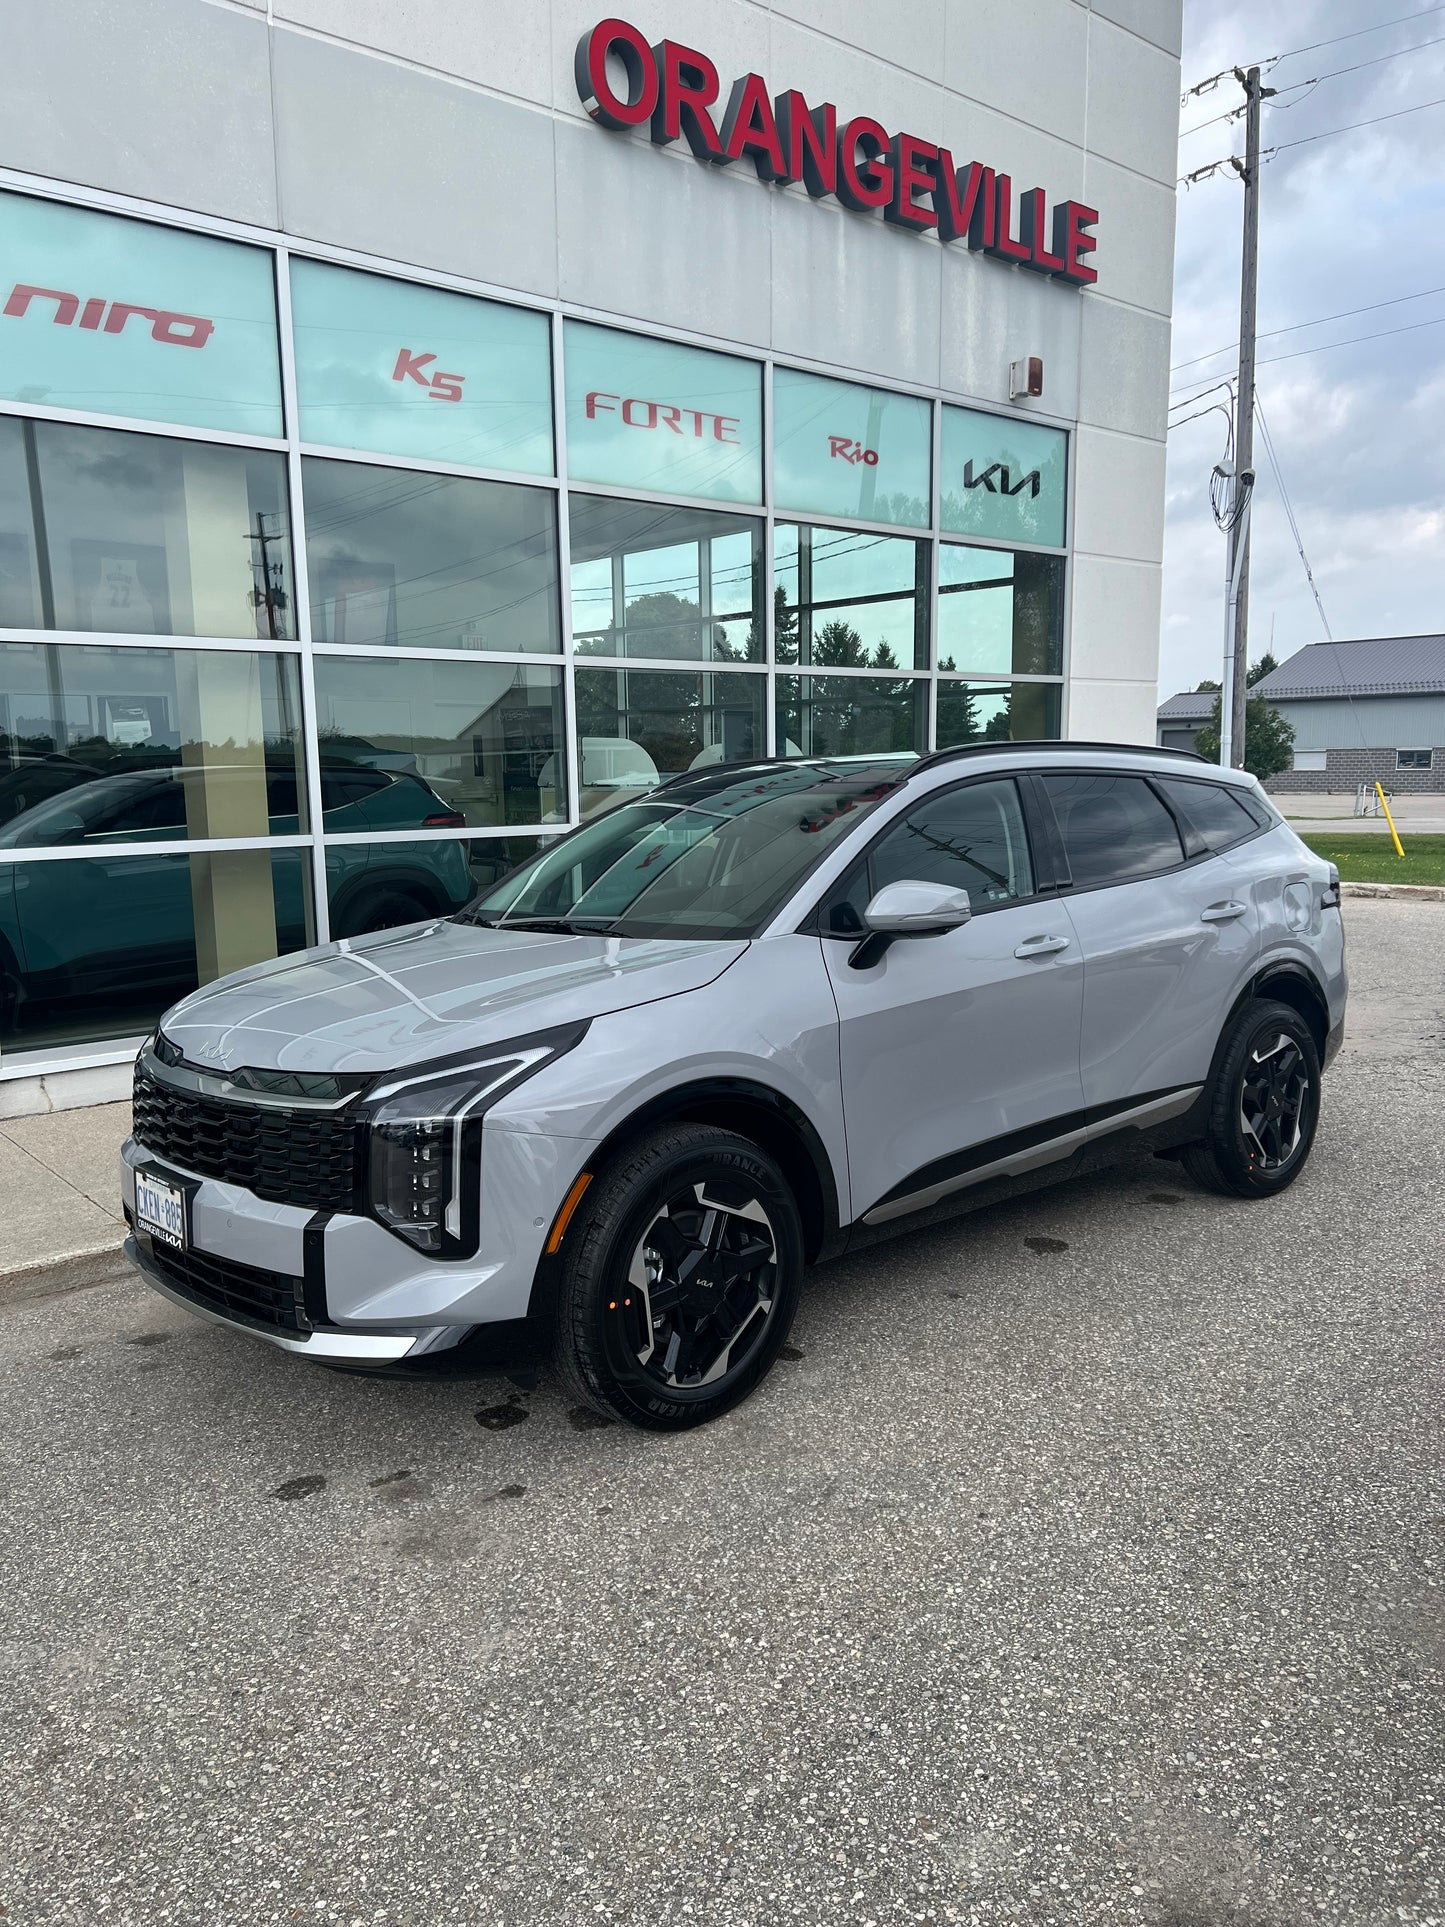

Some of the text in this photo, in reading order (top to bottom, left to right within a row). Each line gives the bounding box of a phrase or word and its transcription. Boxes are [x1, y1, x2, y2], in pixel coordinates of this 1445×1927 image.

[575, 18, 1099, 286] ORANGEVILLE
[392, 348, 466, 402] K5
[586, 391, 741, 445] FORTE
[828, 435, 879, 466] Rio
[963, 459, 1040, 498] KIA
[137, 1218, 182, 1250] ORANGEVILLE KIA
